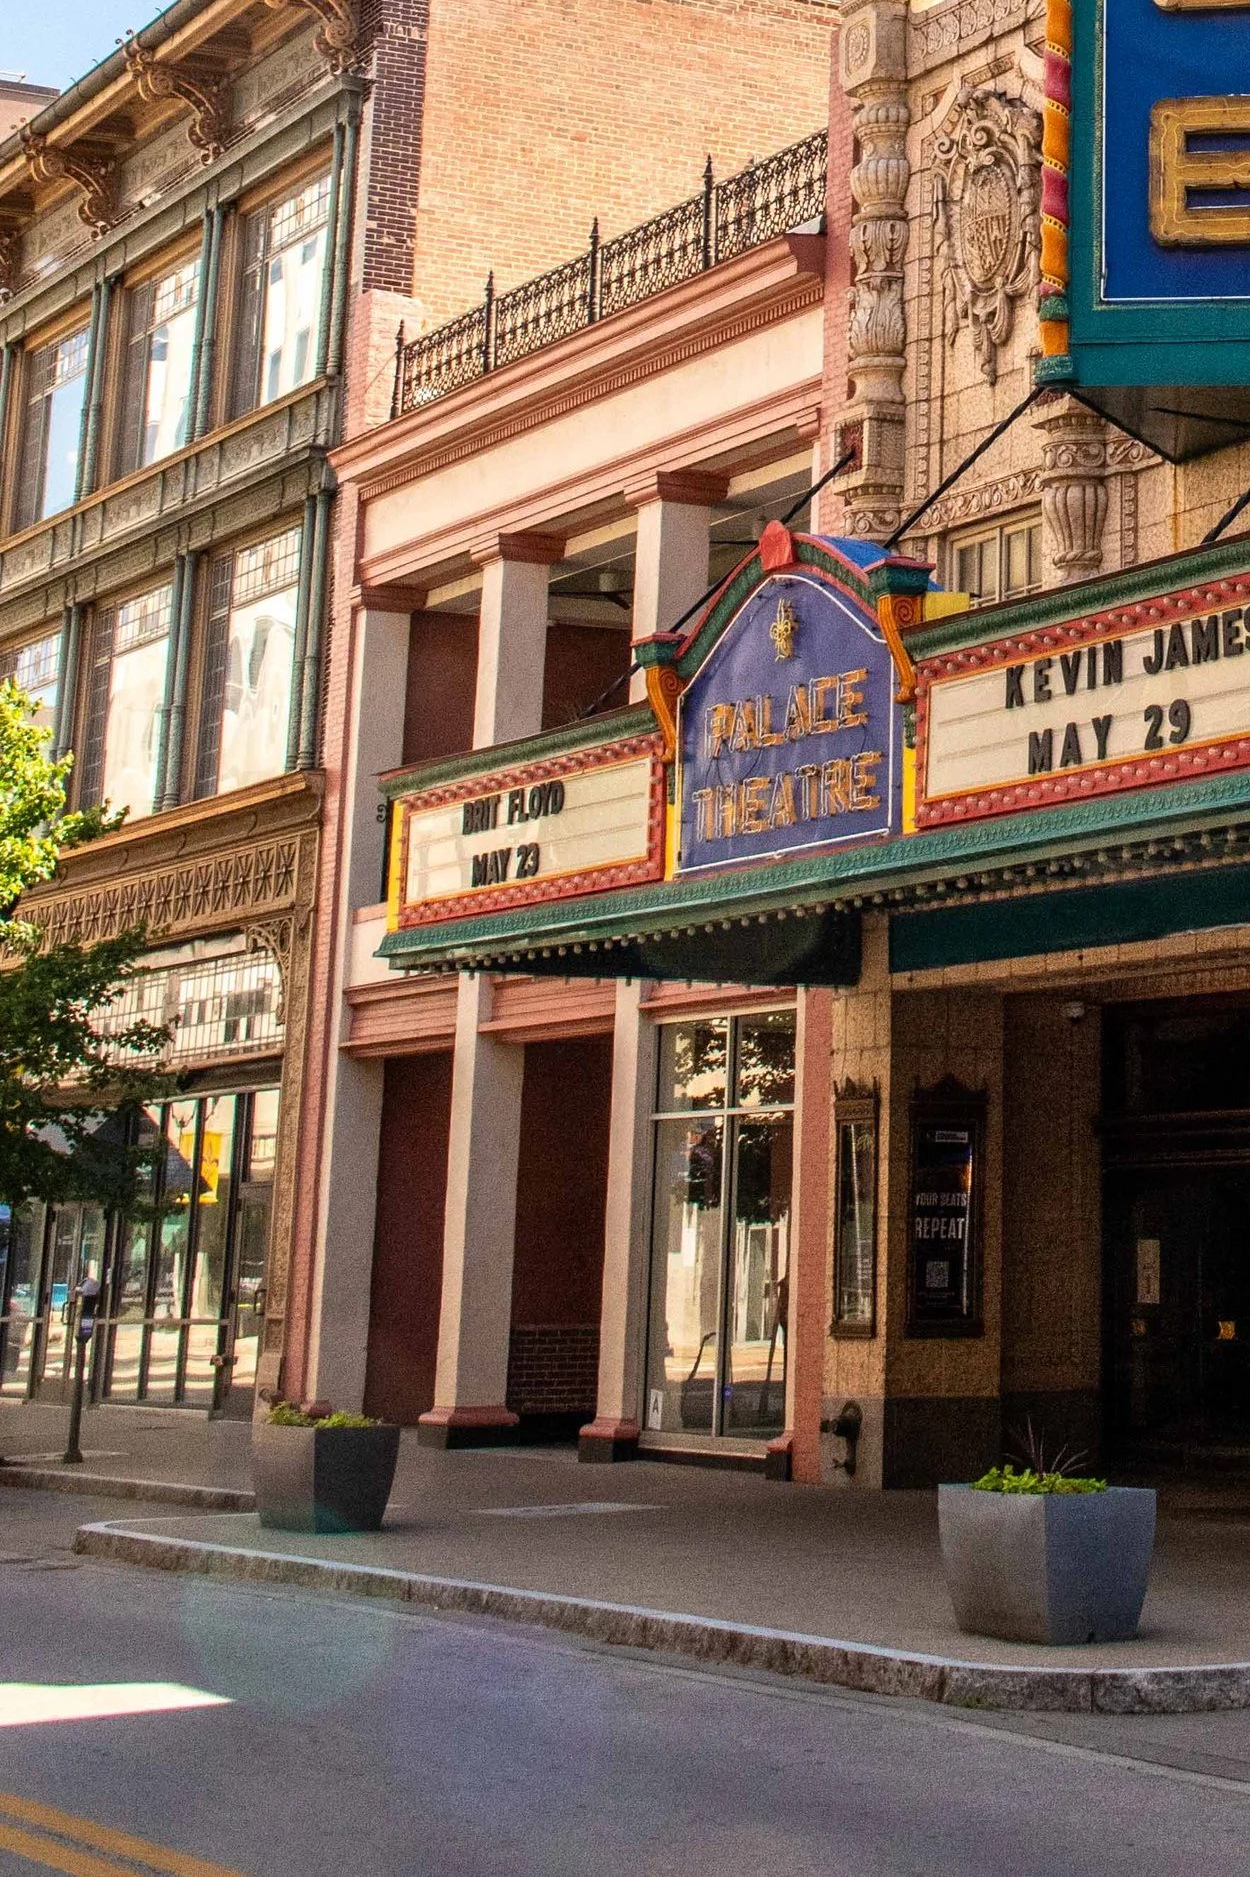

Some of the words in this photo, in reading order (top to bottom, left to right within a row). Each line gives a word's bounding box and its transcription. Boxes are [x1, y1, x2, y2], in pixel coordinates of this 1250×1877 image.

[1005, 639, 1123, 710] KEVIN
[704, 668, 869, 759] PALACE
[1028, 713, 1113, 775] MAY
[1143, 698, 1192, 751] 29
[462, 795, 500, 835] BRIT
[506, 780, 565, 825] FLOYD
[692, 751, 883, 842] THEATRE
[471, 847, 512, 888] MAY
[516, 842, 540, 879] 23
[915, 1218, 965, 1239] REPEAT
